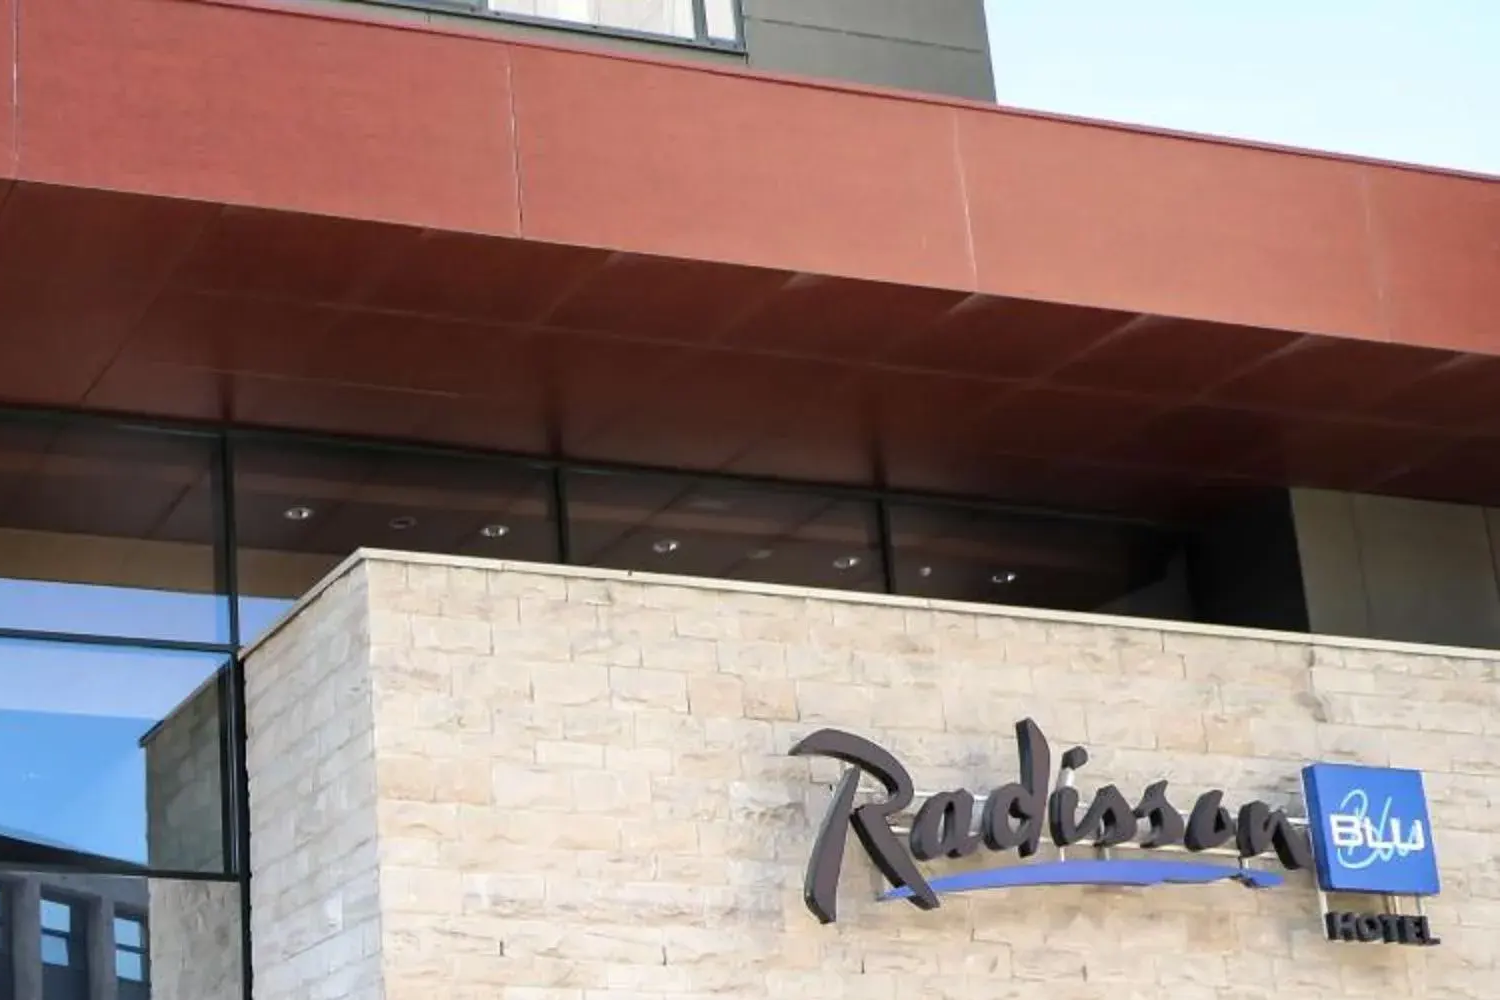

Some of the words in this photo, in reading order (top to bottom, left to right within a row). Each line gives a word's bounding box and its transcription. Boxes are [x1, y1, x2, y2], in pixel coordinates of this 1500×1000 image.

[788, 717, 1314, 923] Radisson
[1329, 813, 1425, 851] BLU
[1325, 911, 1441, 945] HOTEL
